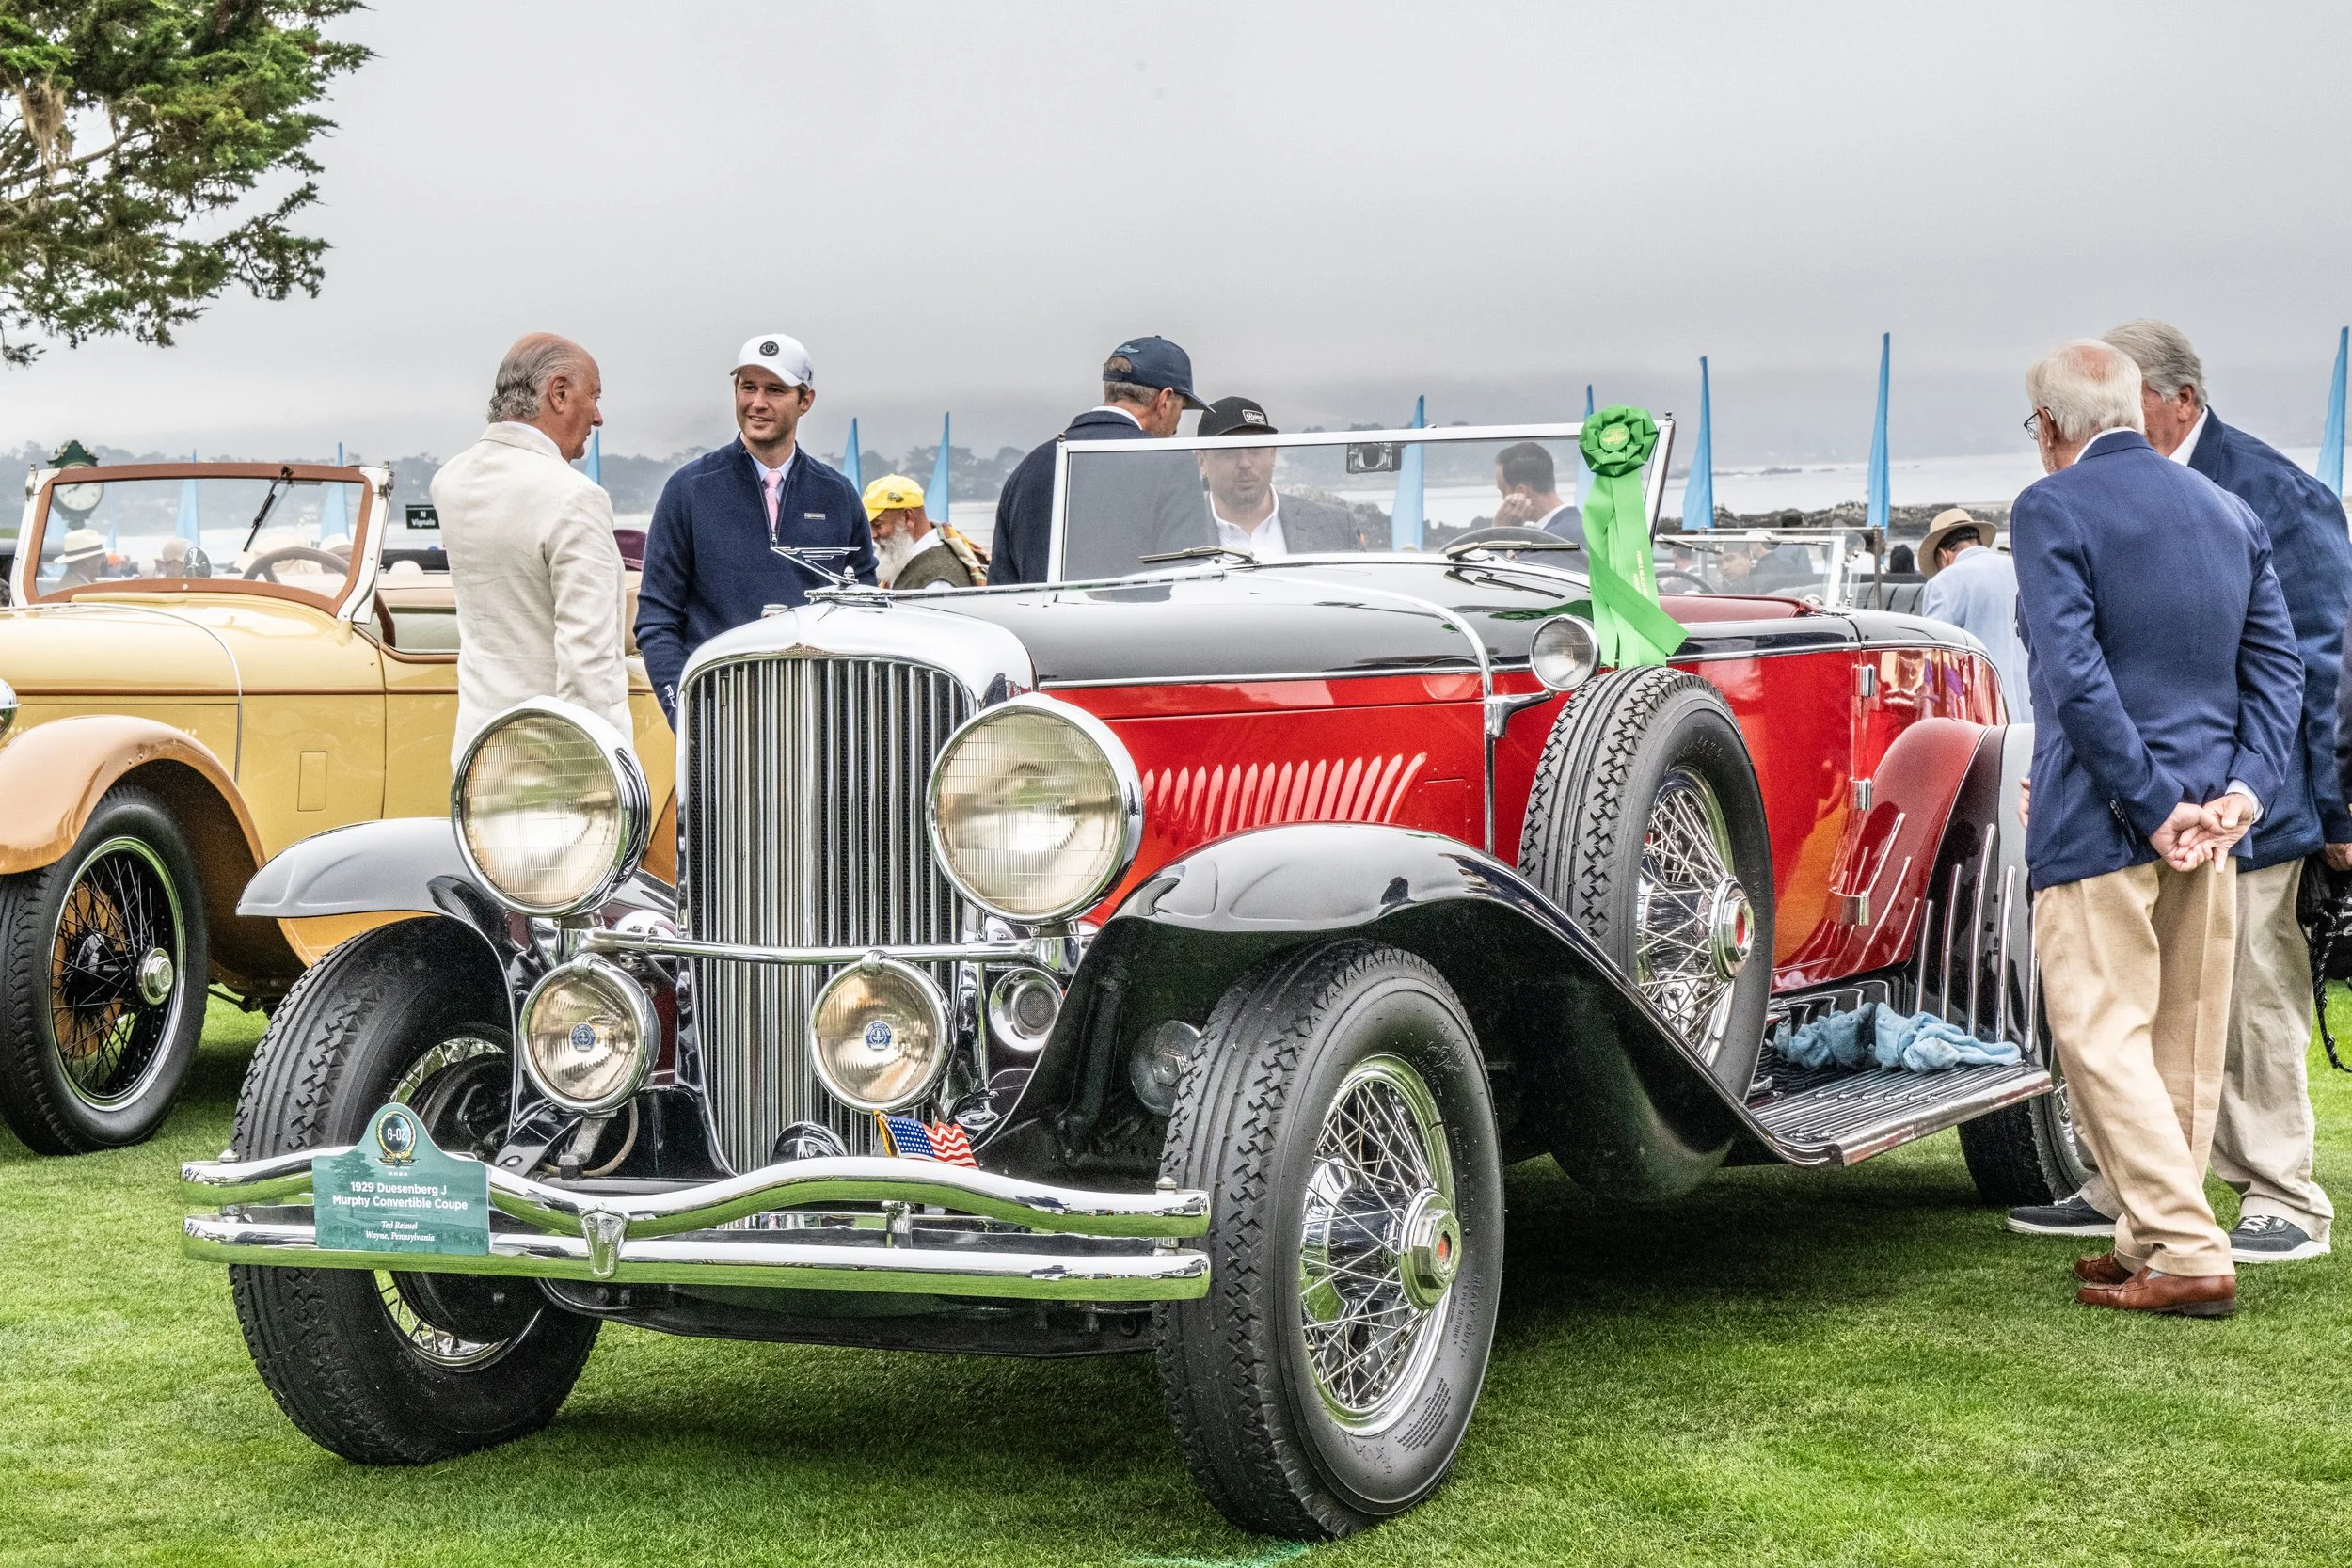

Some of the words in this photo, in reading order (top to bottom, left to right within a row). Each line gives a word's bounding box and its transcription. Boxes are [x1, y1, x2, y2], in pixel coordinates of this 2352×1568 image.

[387, 1127, 406, 1142] G-02
[350, 1181, 374, 1193] 1929
[376, 1182, 438, 1196] Duesenberg
[440, 1184, 447, 1196] J
[332, 1195, 371, 1208] Murphy
[373, 1196, 432, 1209] Convertible
[434, 1198, 469, 1212] Coupe
[381, 1220, 394, 1229] Ted
[395, 1221, 419, 1230] Reimel
[365, 1230, 389, 1242] Wayne,
[390, 1231, 436, 1243] Pennsylvania
[1469, 1275, 1482, 1316] HEAVY
